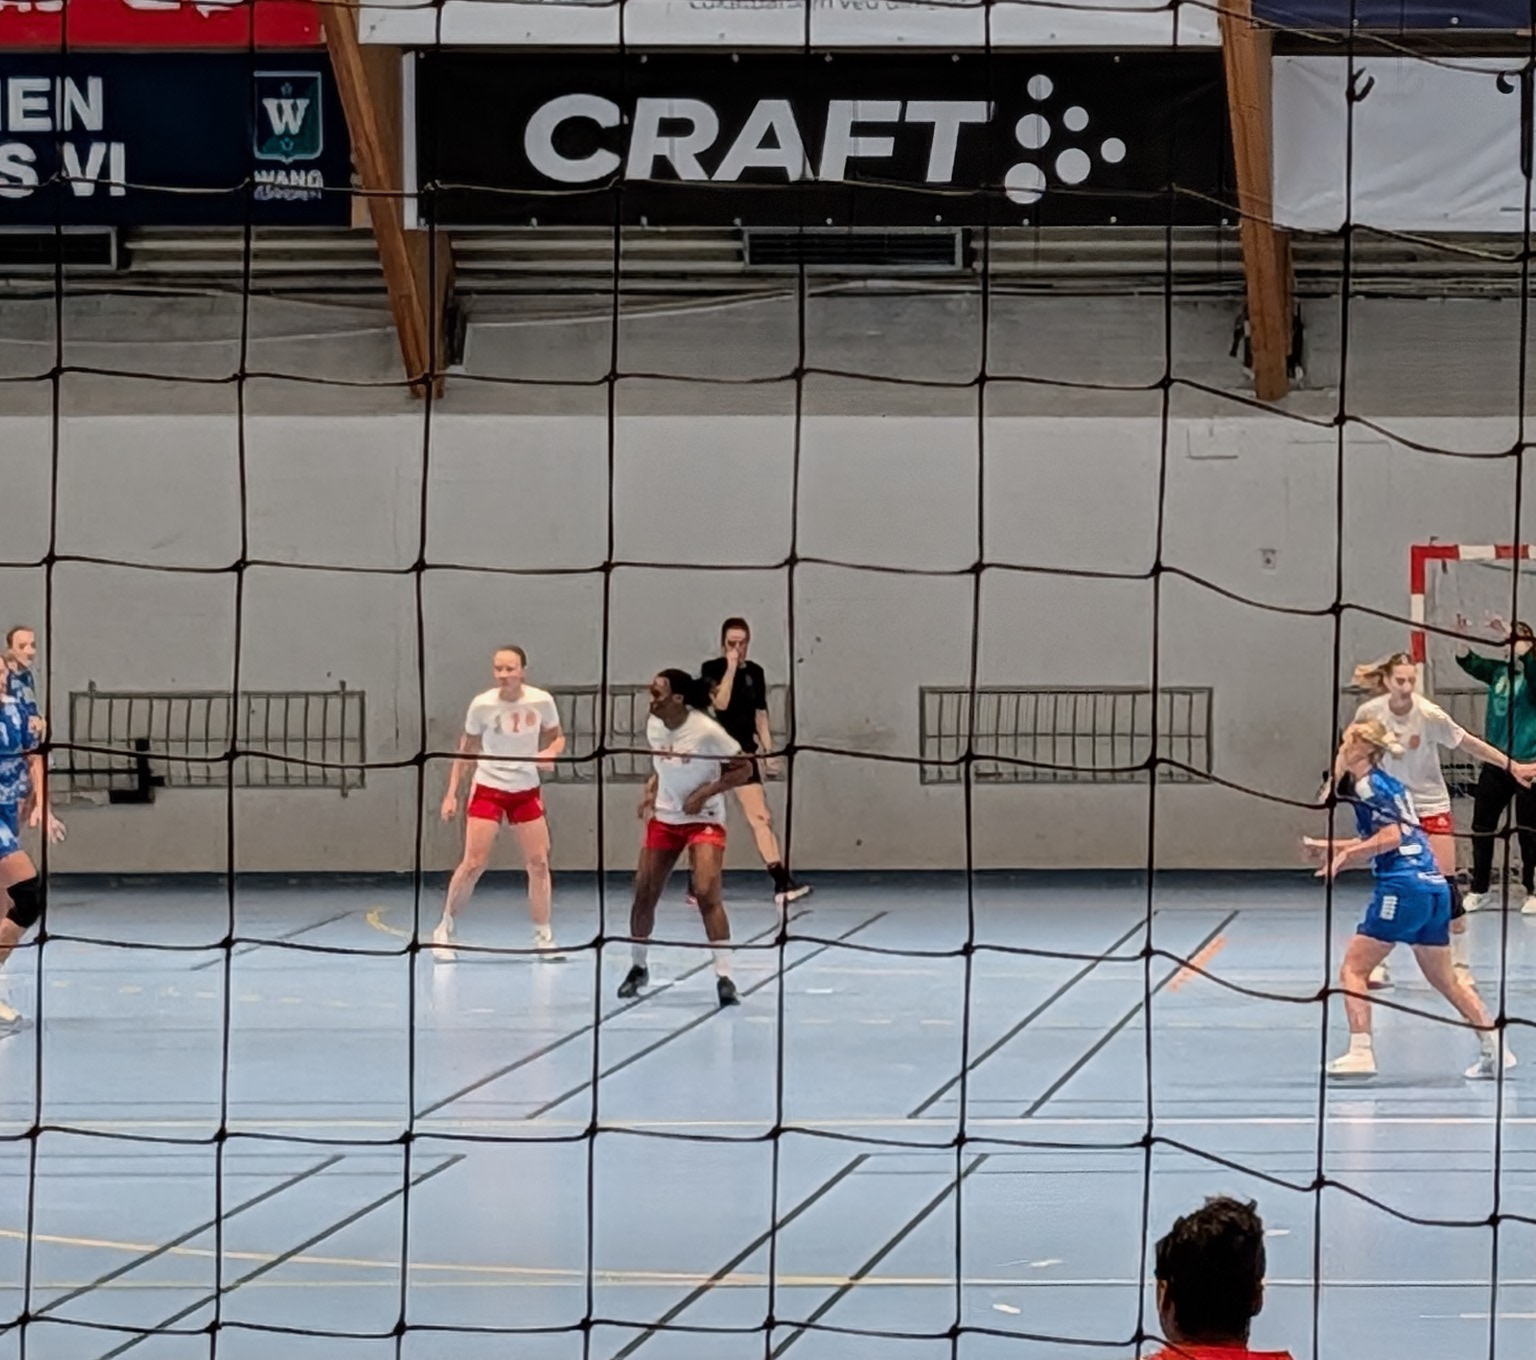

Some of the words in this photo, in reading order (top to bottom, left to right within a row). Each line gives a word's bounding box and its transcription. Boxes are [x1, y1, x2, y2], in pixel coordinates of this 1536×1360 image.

[262, 97, 311, 136] W
[524, 92, 995, 183] CRAFT
[62, 141, 126, 197] VI
